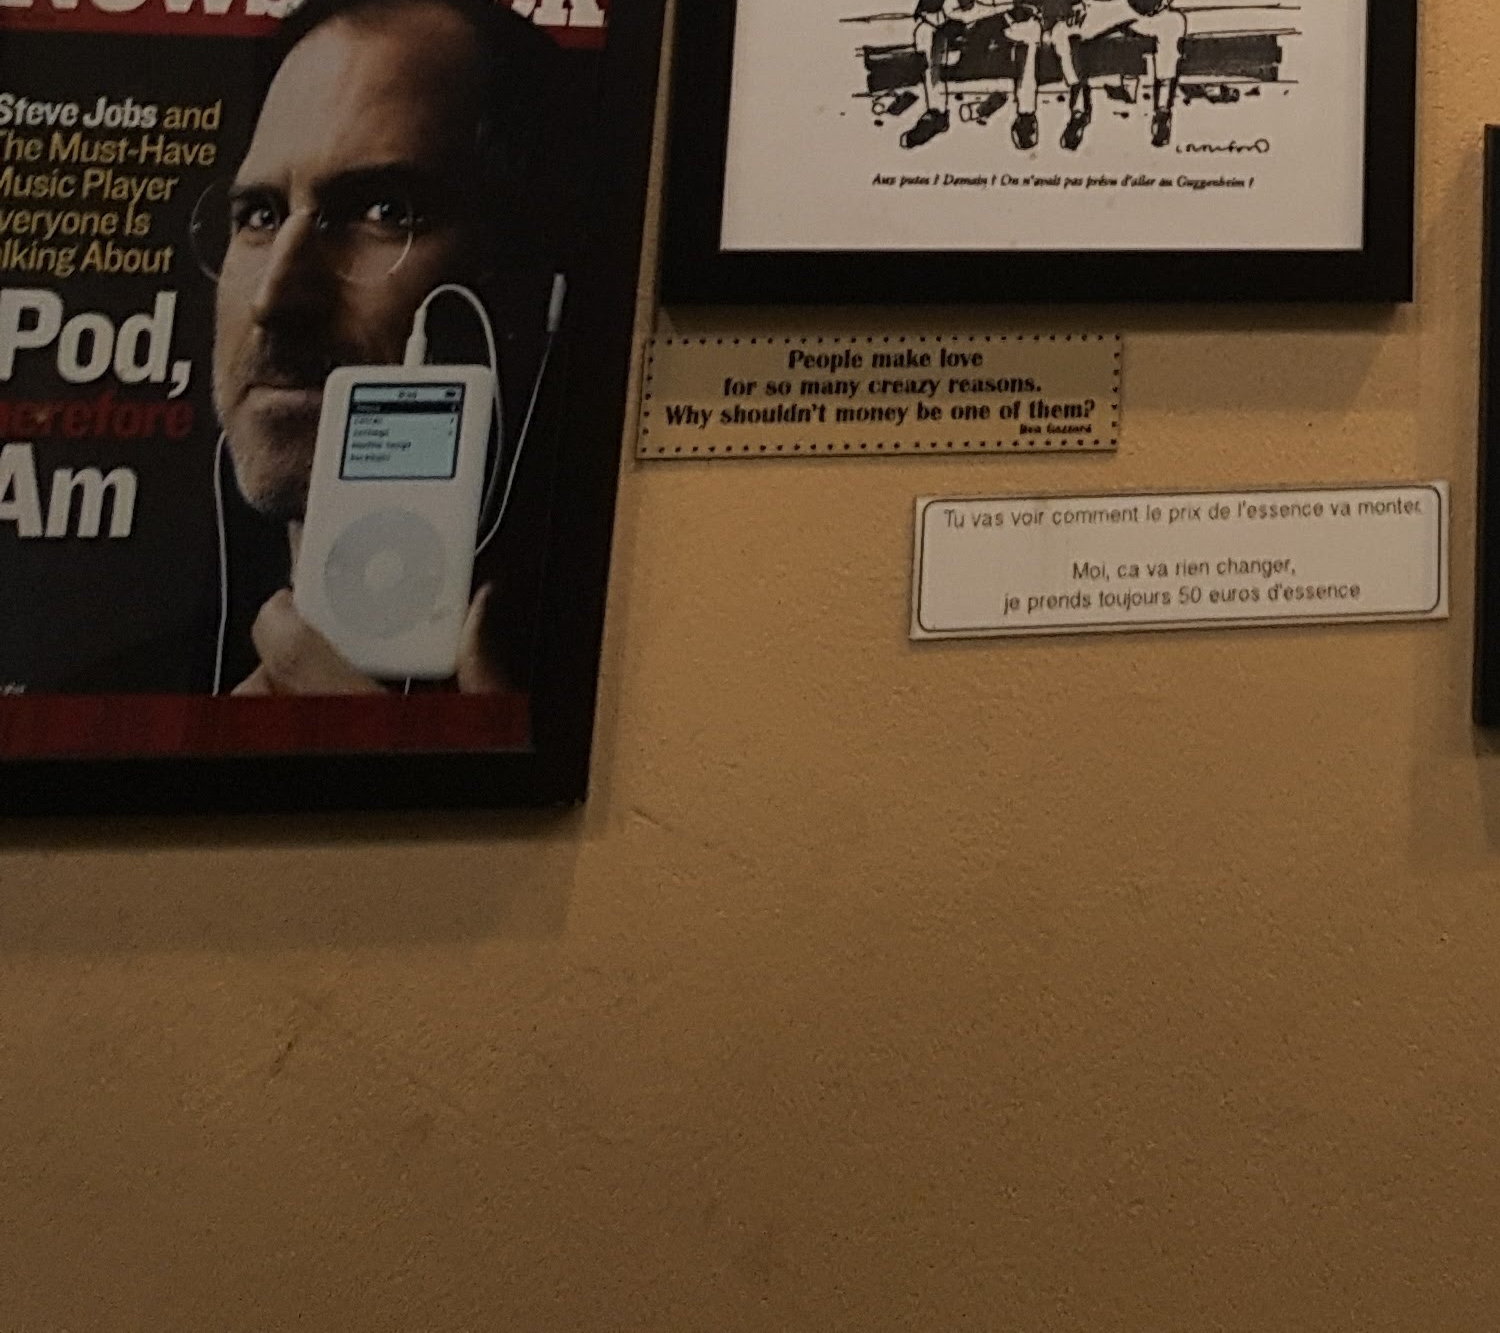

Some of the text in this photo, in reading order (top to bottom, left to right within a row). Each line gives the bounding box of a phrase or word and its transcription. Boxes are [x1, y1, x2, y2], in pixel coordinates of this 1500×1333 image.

[0, 91, 223, 132] Steve Jobs and
[48, 131, 217, 167] Must-Have
[788, 343, 984, 372] People make love
[724, 377, 758, 397] for
[764, 379, 792, 396] so
[800, 379, 860, 399] many
[947, 377, 1042, 395] reasons.
[0, 440, 138, 539] Am
[943, 508, 966, 529] Tu
[972, 509, 1004, 527] vas
[1011, 508, 1045, 526] voir
[1051, 505, 1139, 525] comment
[1145, 504, 1163, 523] le
[1168, 503, 1202, 525] prix
[1208, 501, 1231, 521] de
[1236, 499, 1323, 520] l'essence
[1330, 500, 1351, 516] va
